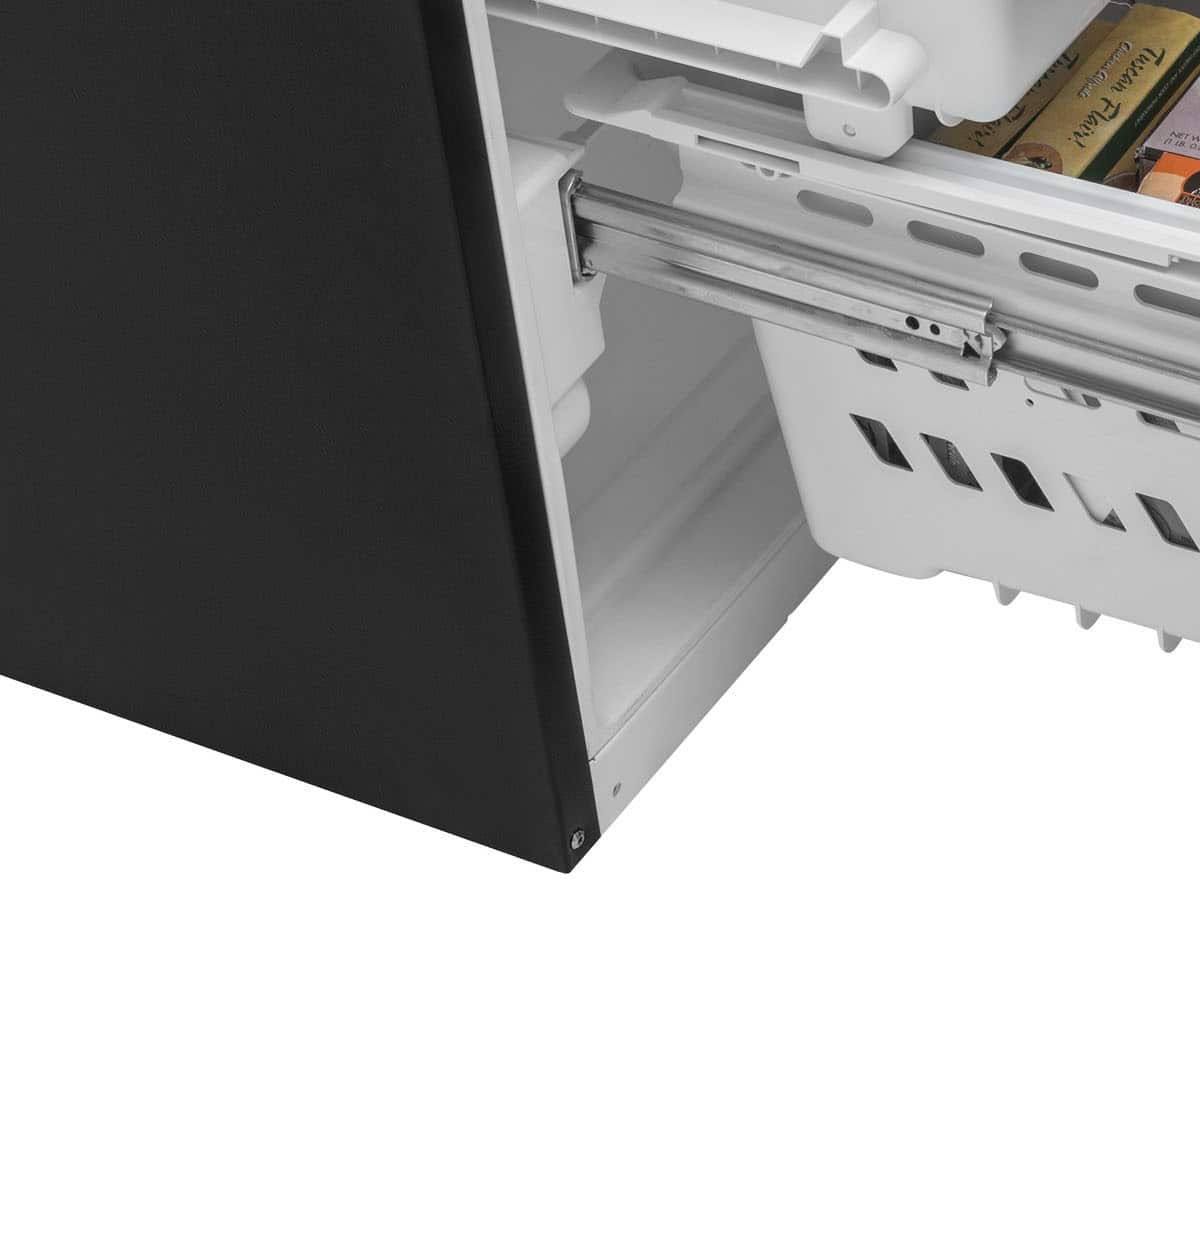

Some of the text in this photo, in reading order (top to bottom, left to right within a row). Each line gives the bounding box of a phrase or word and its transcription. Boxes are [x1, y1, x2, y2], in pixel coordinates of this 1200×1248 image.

[1067, 46, 1167, 149] Tuscan Flair!
[1169, 131, 1190, 142] NET
